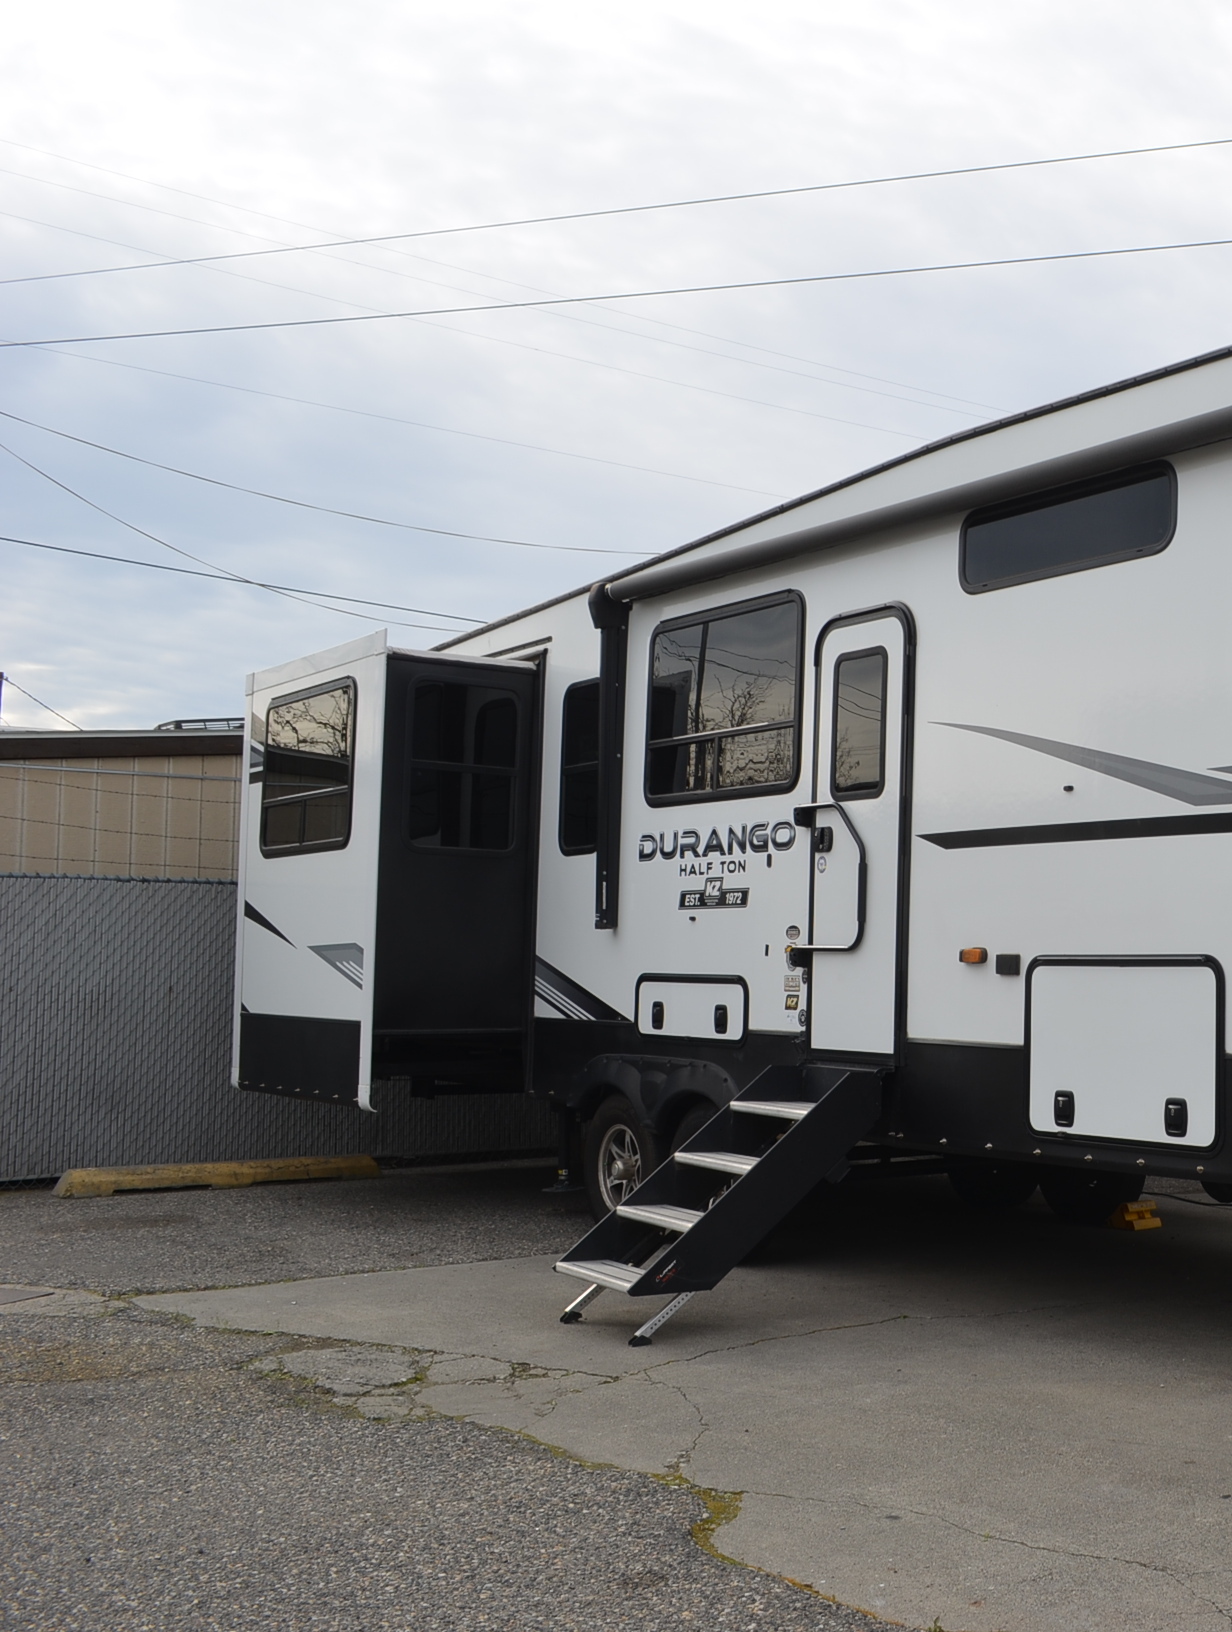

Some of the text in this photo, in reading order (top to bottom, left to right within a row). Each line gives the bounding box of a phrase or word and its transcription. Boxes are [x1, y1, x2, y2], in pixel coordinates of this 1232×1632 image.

[639, 820, 796, 862] DURANGO
[679, 860, 746, 877] HALF TON
[705, 881, 721, 897] KZ
[684, 894, 701, 906] EST.
[725, 892, 742, 905] 1972
